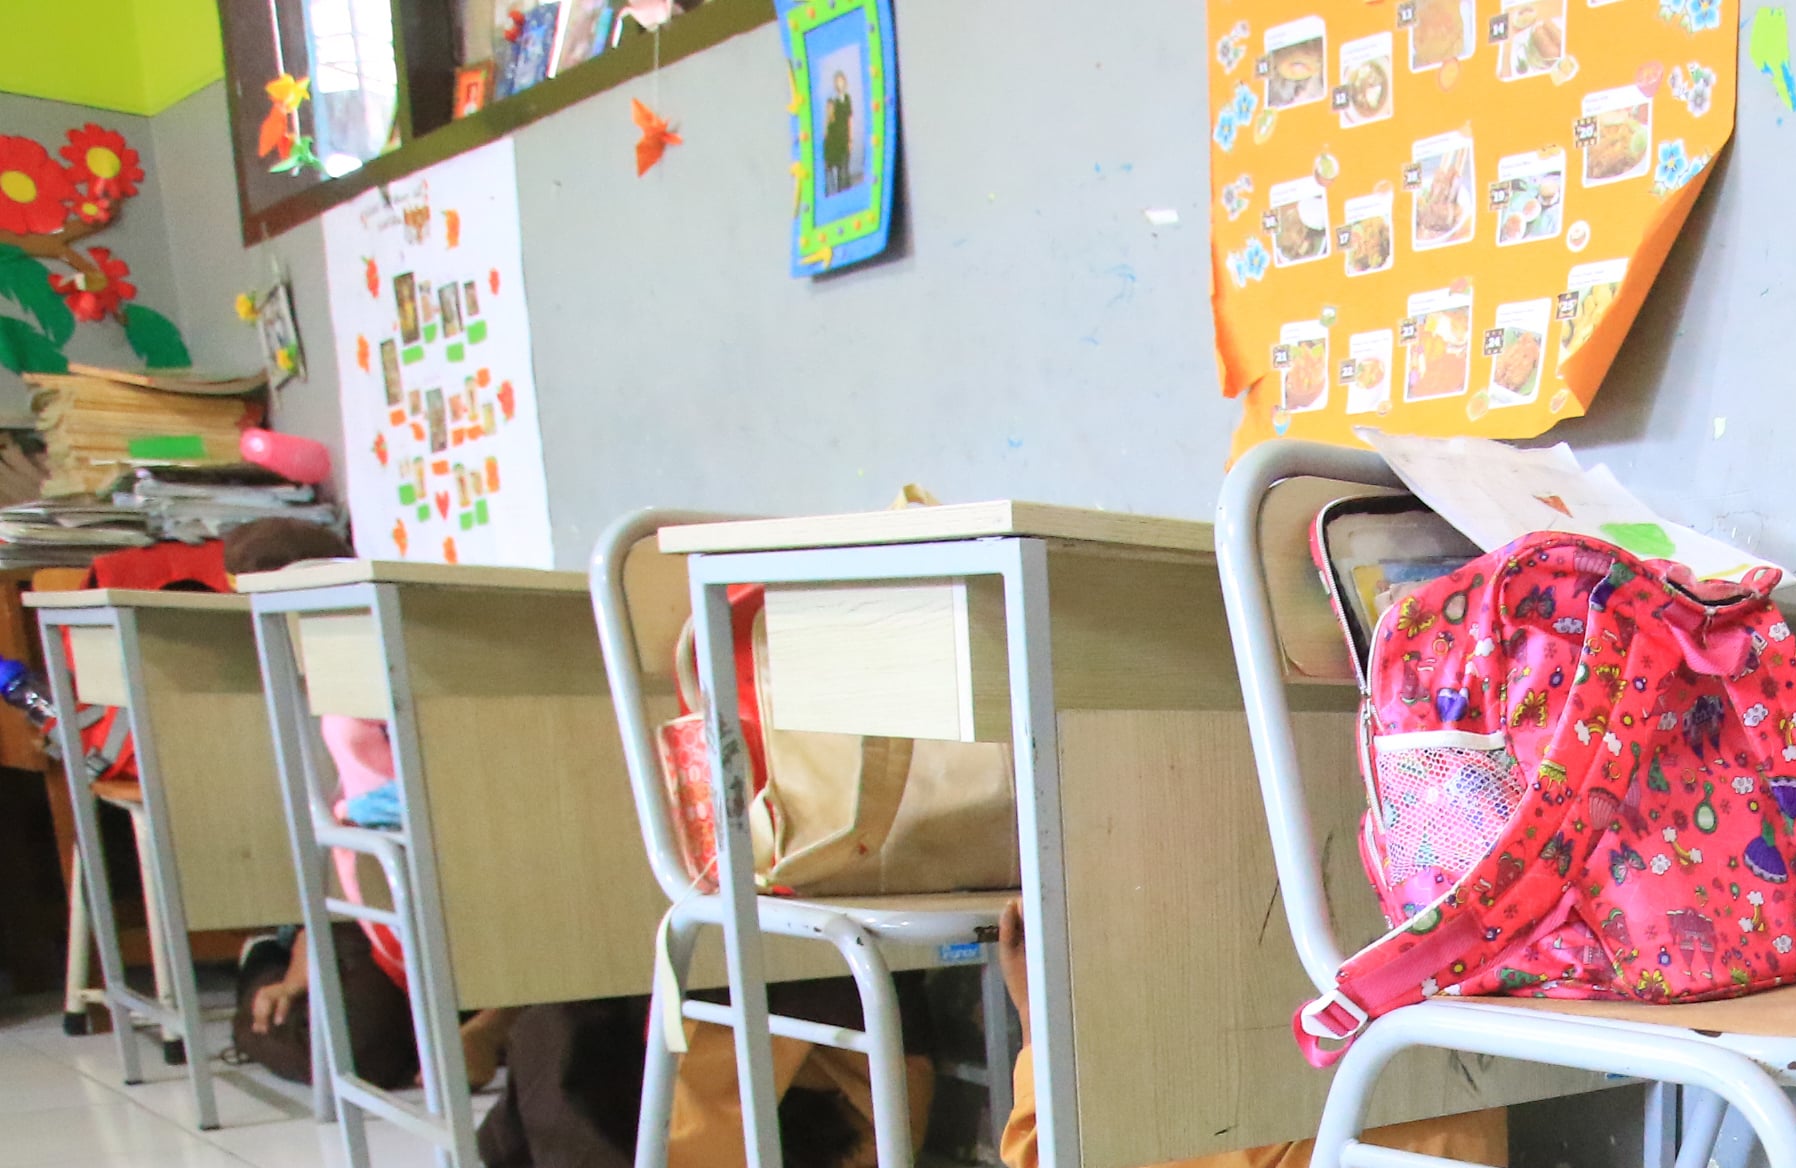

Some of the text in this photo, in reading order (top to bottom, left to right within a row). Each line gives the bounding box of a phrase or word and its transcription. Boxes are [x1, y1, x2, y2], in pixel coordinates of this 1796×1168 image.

[1492, 23, 1506, 36] 14
[1579, 124, 1594, 139] 20
[1560, 299, 1575, 314] 25
